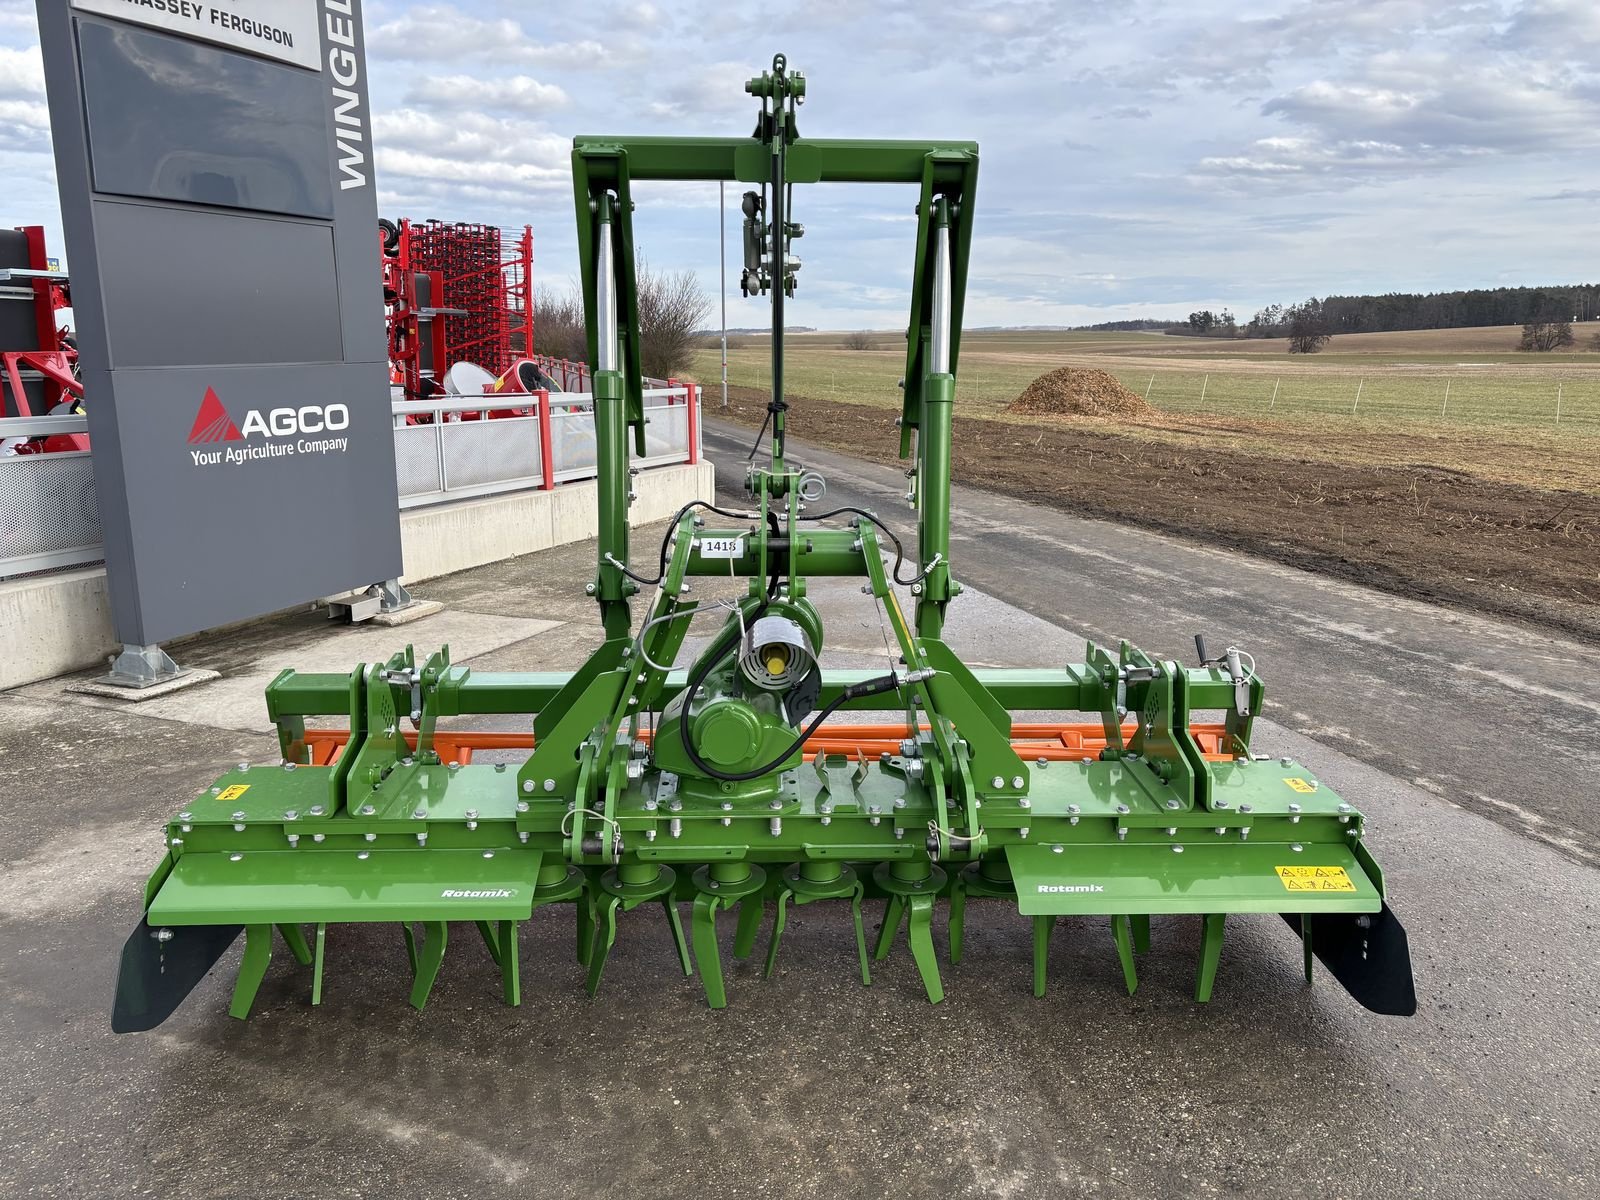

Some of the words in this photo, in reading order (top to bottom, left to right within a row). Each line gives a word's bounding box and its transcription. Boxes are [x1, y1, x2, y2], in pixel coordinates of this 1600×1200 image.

[121, 0, 203, 20] ASSEY
[210, 8, 294, 48] FERGUSON
[241, 403, 350, 440] AGCO
[190, 449, 222, 466] Your
[225, 441, 294, 465] Agriculture
[297, 437, 348, 455] Company
[706, 541, 737, 551] 1418
[440, 888, 512, 898] Rotamix
[1037, 884, 1104, 893] Rotamix
